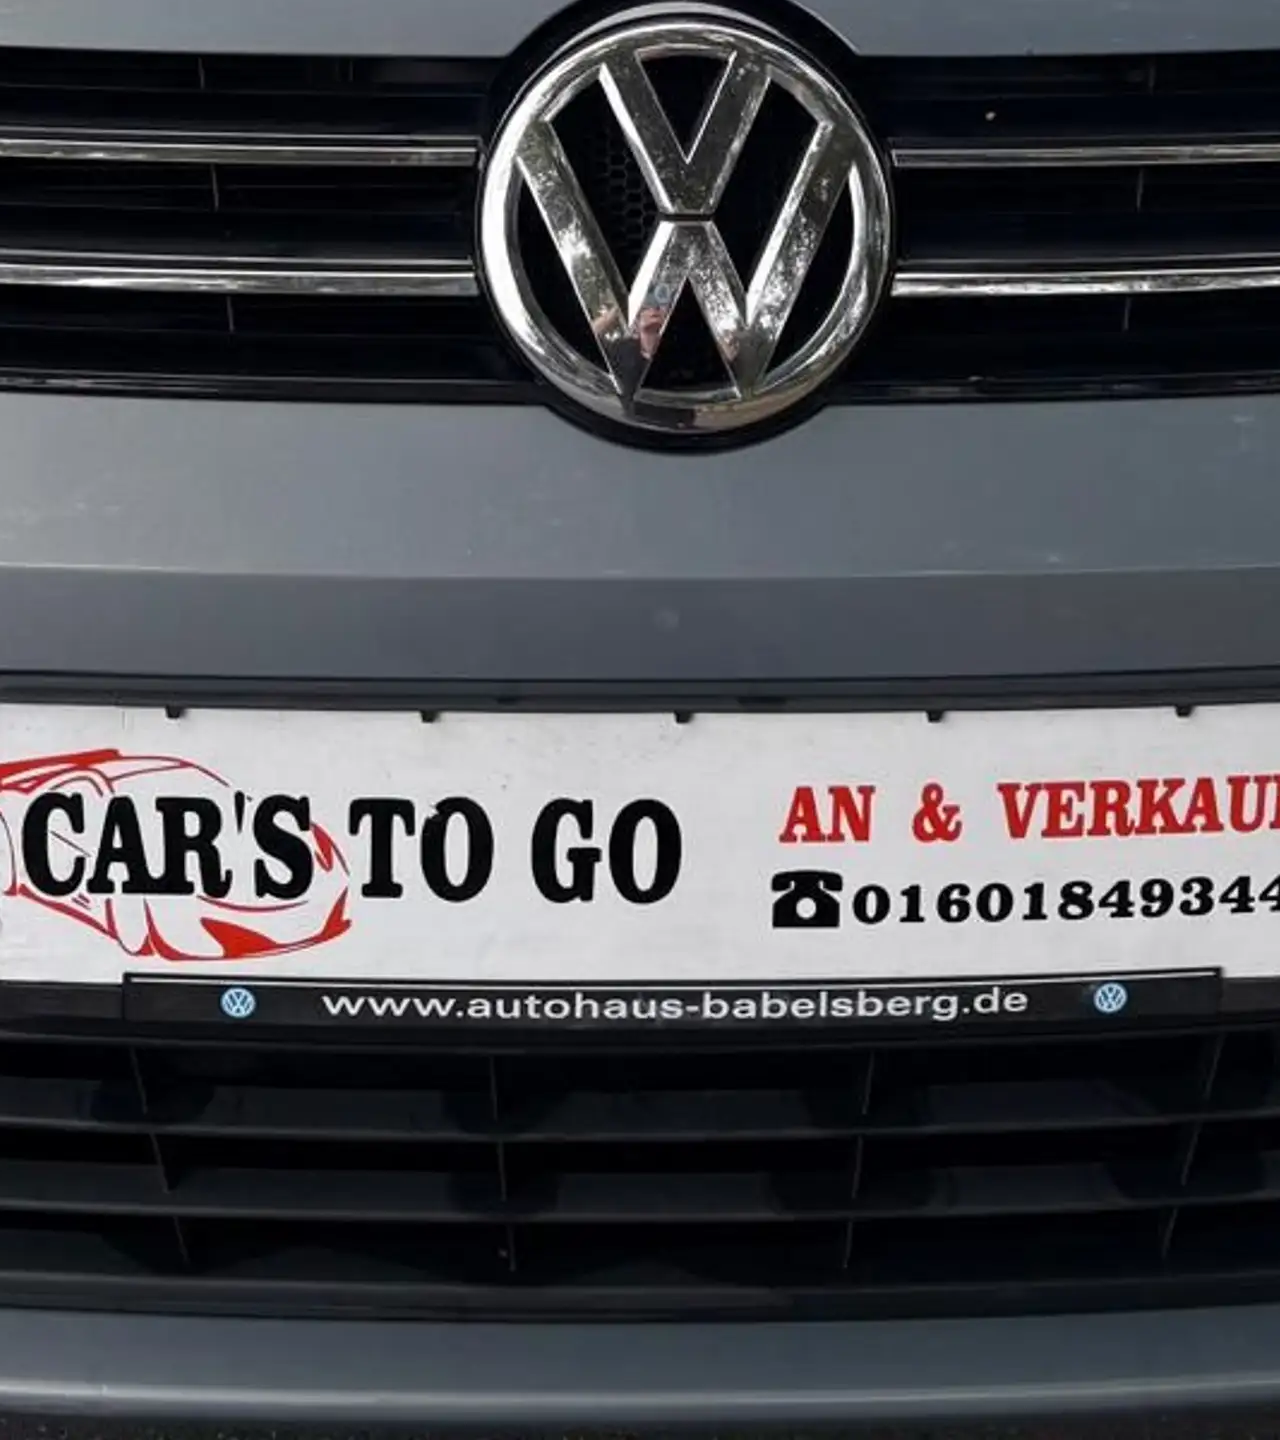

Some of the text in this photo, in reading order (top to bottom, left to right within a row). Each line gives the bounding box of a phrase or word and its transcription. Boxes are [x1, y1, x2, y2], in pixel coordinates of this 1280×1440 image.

[500, 30, 870, 410] VW
[20, 790, 683, 905] CAR'S TO GO
[778, 785, 875, 843] AN
[912, 783, 961, 843] &
[321, 987, 1029, 1022] www.autohaus-babelsberg.de
